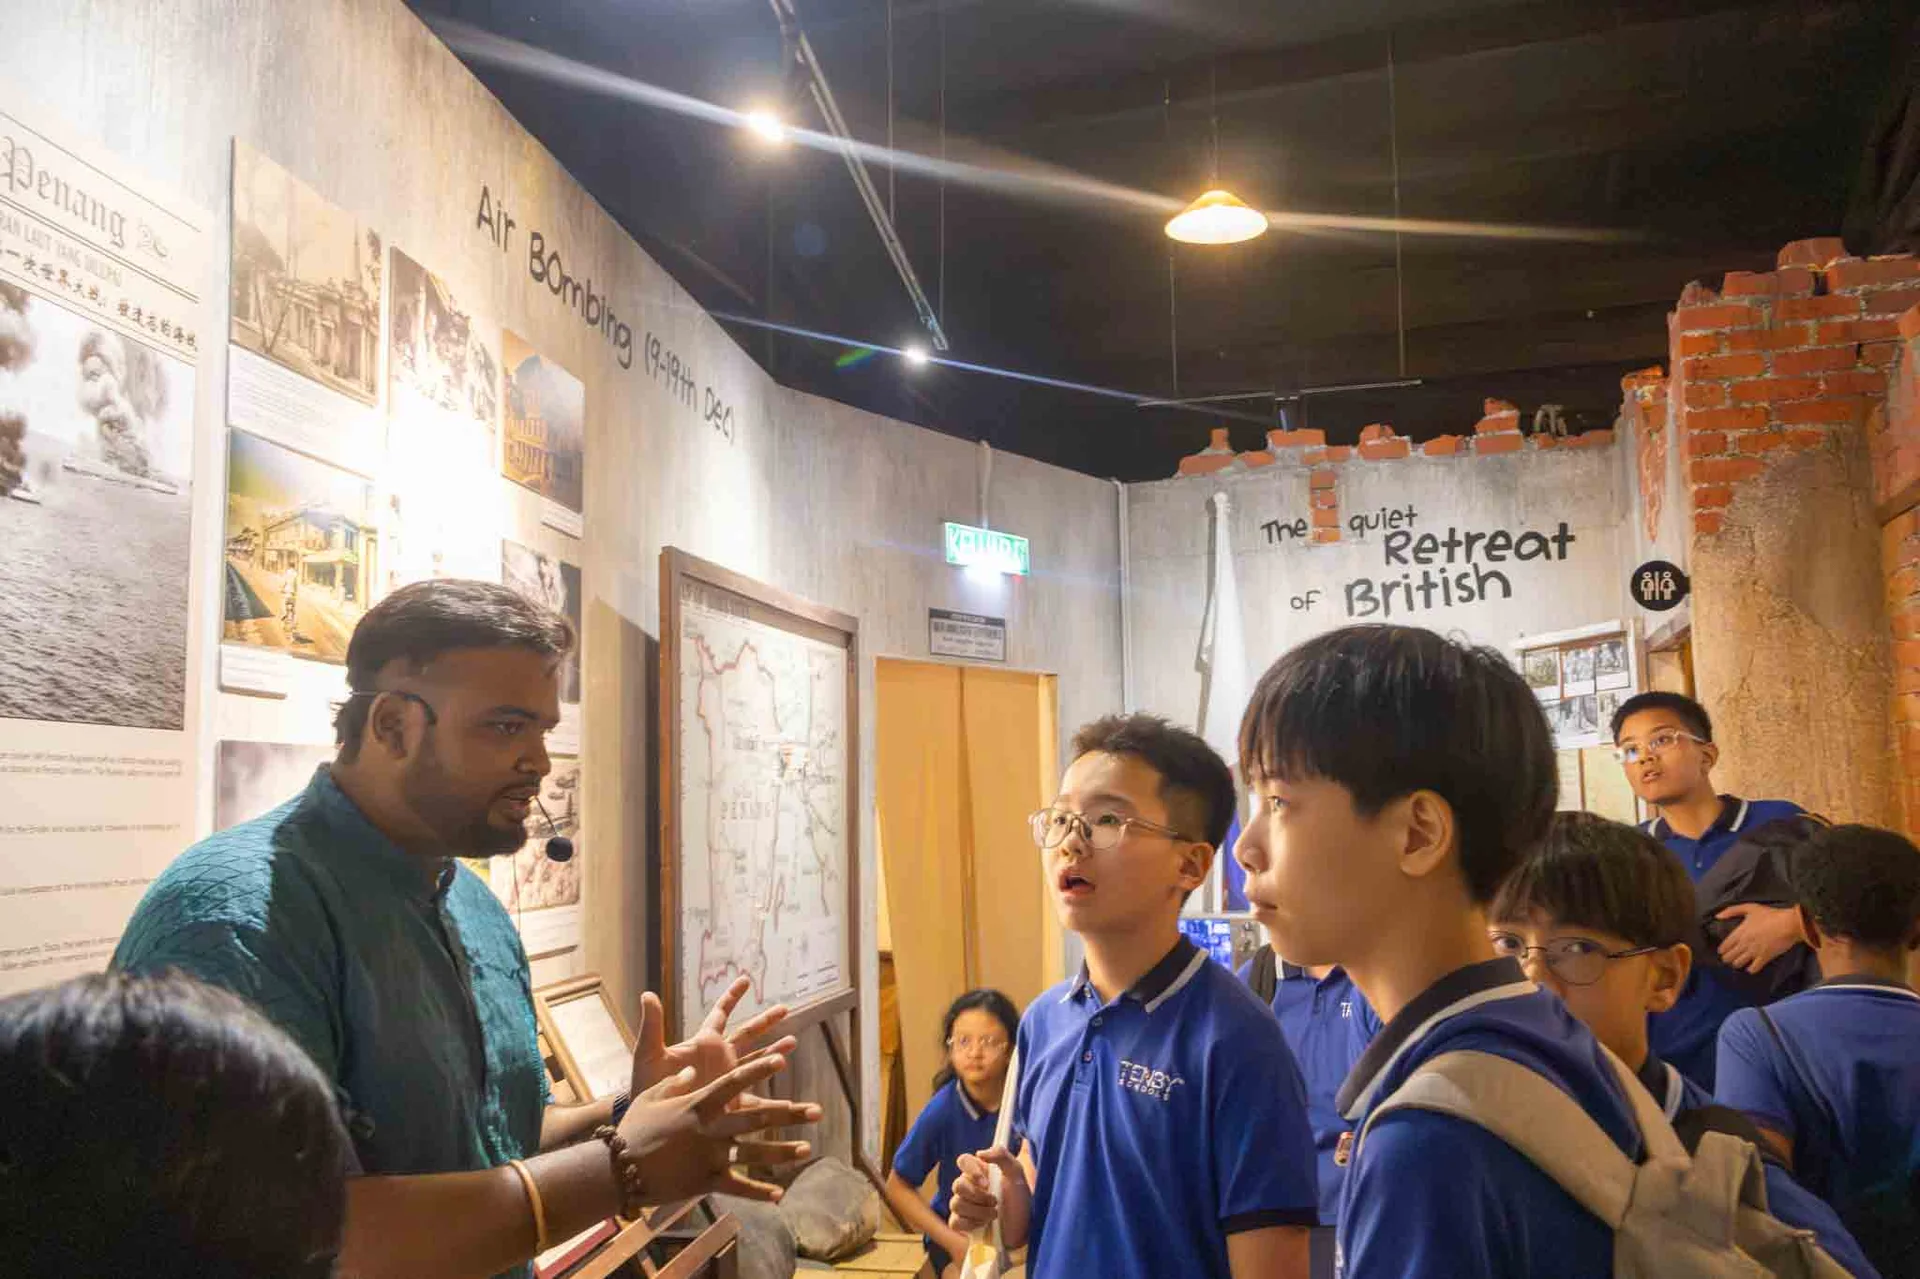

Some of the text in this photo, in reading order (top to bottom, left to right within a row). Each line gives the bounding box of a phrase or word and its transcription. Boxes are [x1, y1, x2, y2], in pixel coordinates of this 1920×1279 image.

[0, 136, 127, 248] Penang
[477, 185, 516, 252] Air
[1261, 504, 1418, 544] The quiet
[1384, 522, 1576, 567] Retreat
[1344, 562, 1512, 618] British
